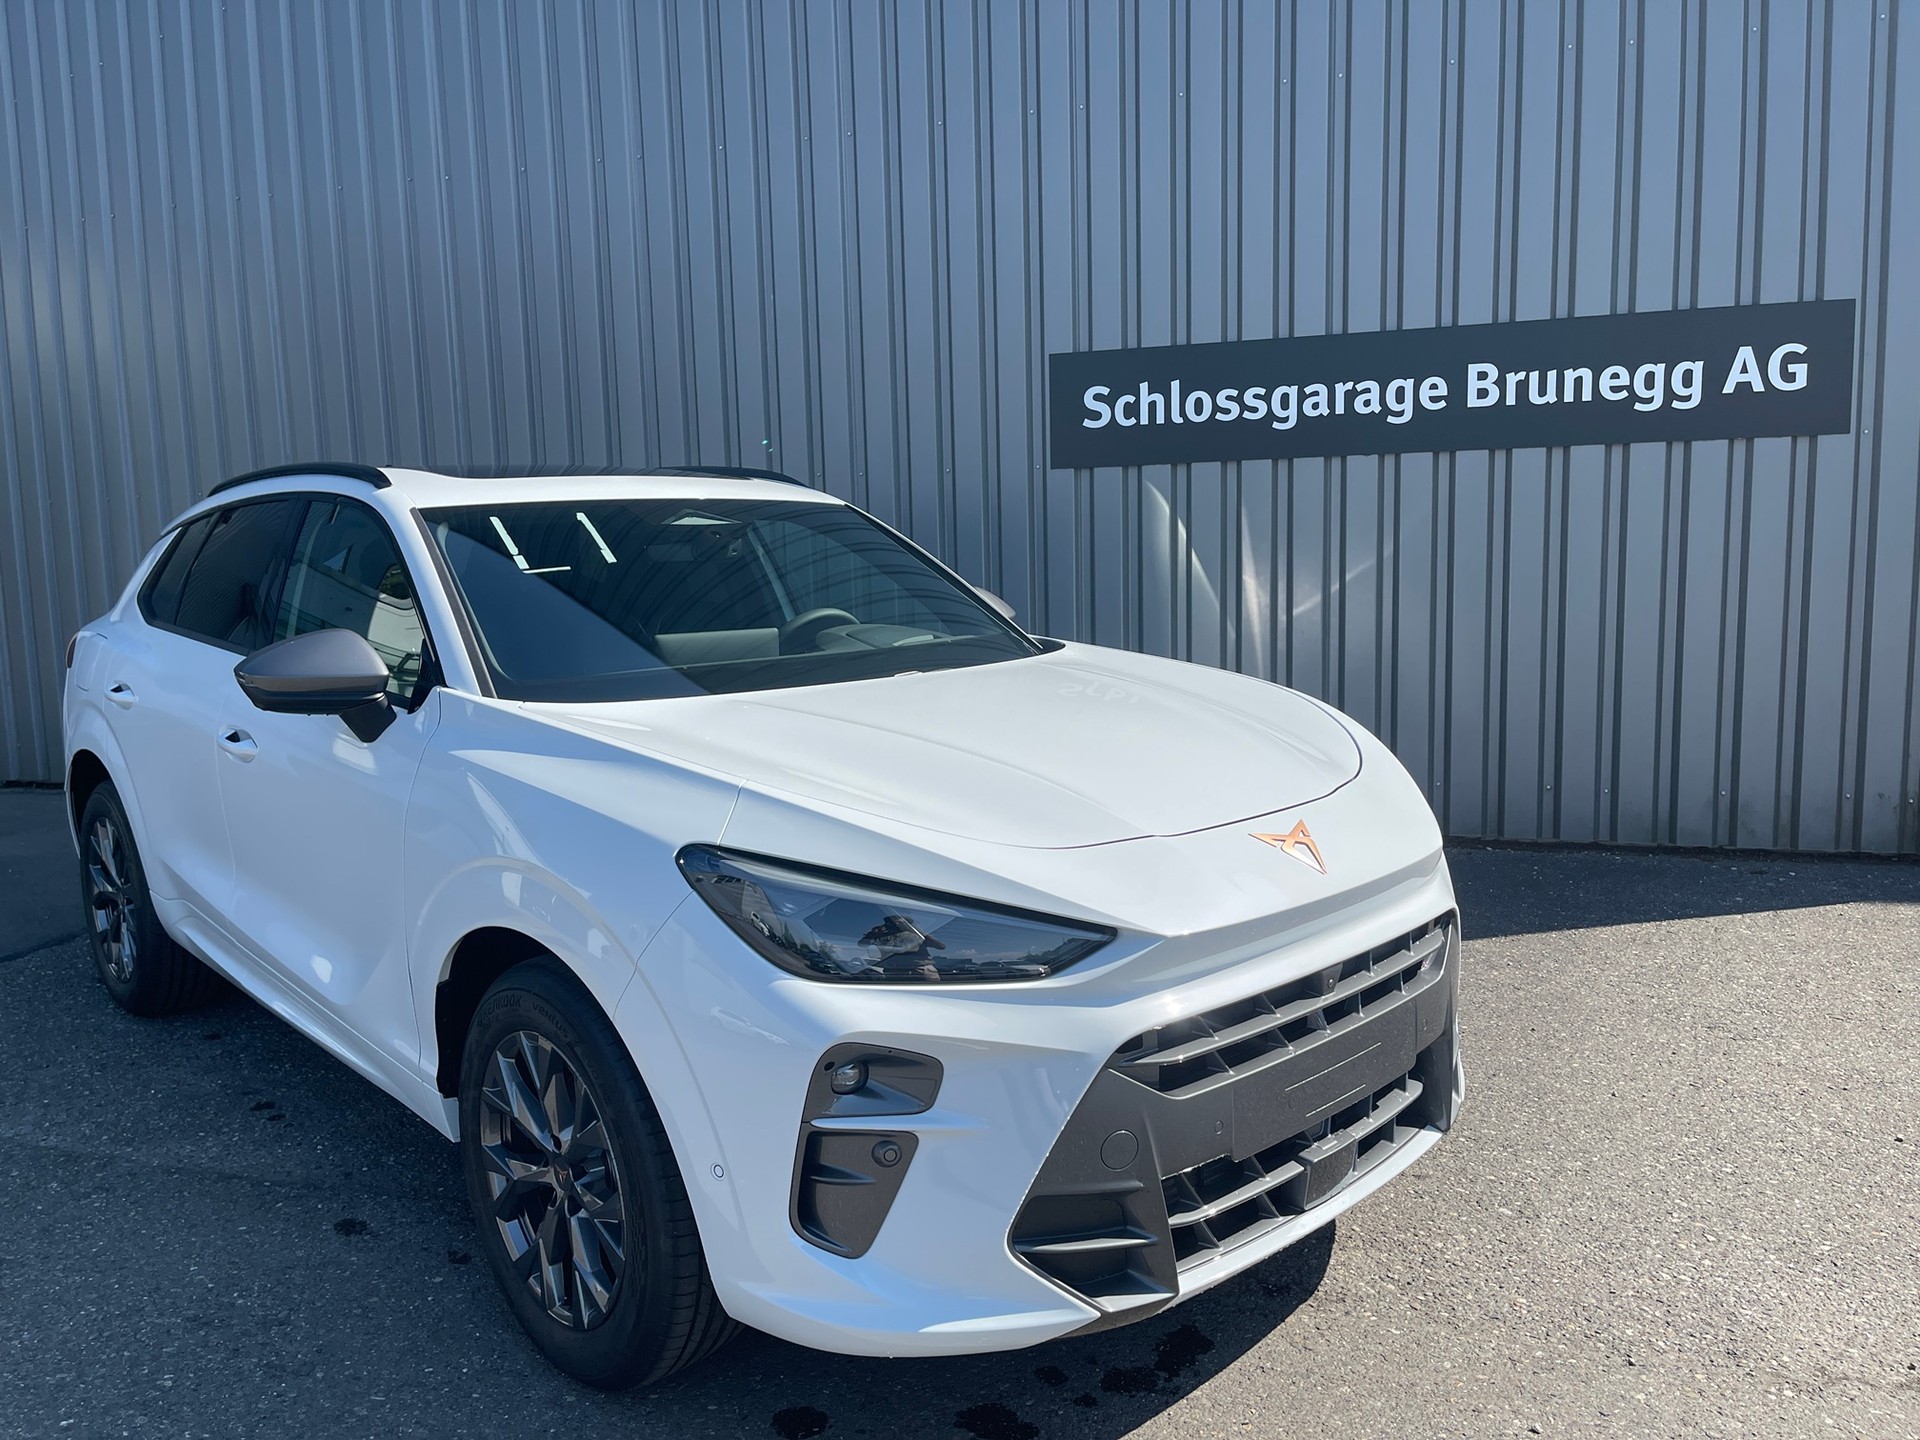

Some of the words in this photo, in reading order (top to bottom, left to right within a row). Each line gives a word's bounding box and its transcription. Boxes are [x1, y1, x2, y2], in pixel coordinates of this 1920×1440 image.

[1082, 376, 1448, 430] Schlossgarage
[1467, 361, 1705, 412] Brunegg
[1721, 342, 1808, 394] AG
